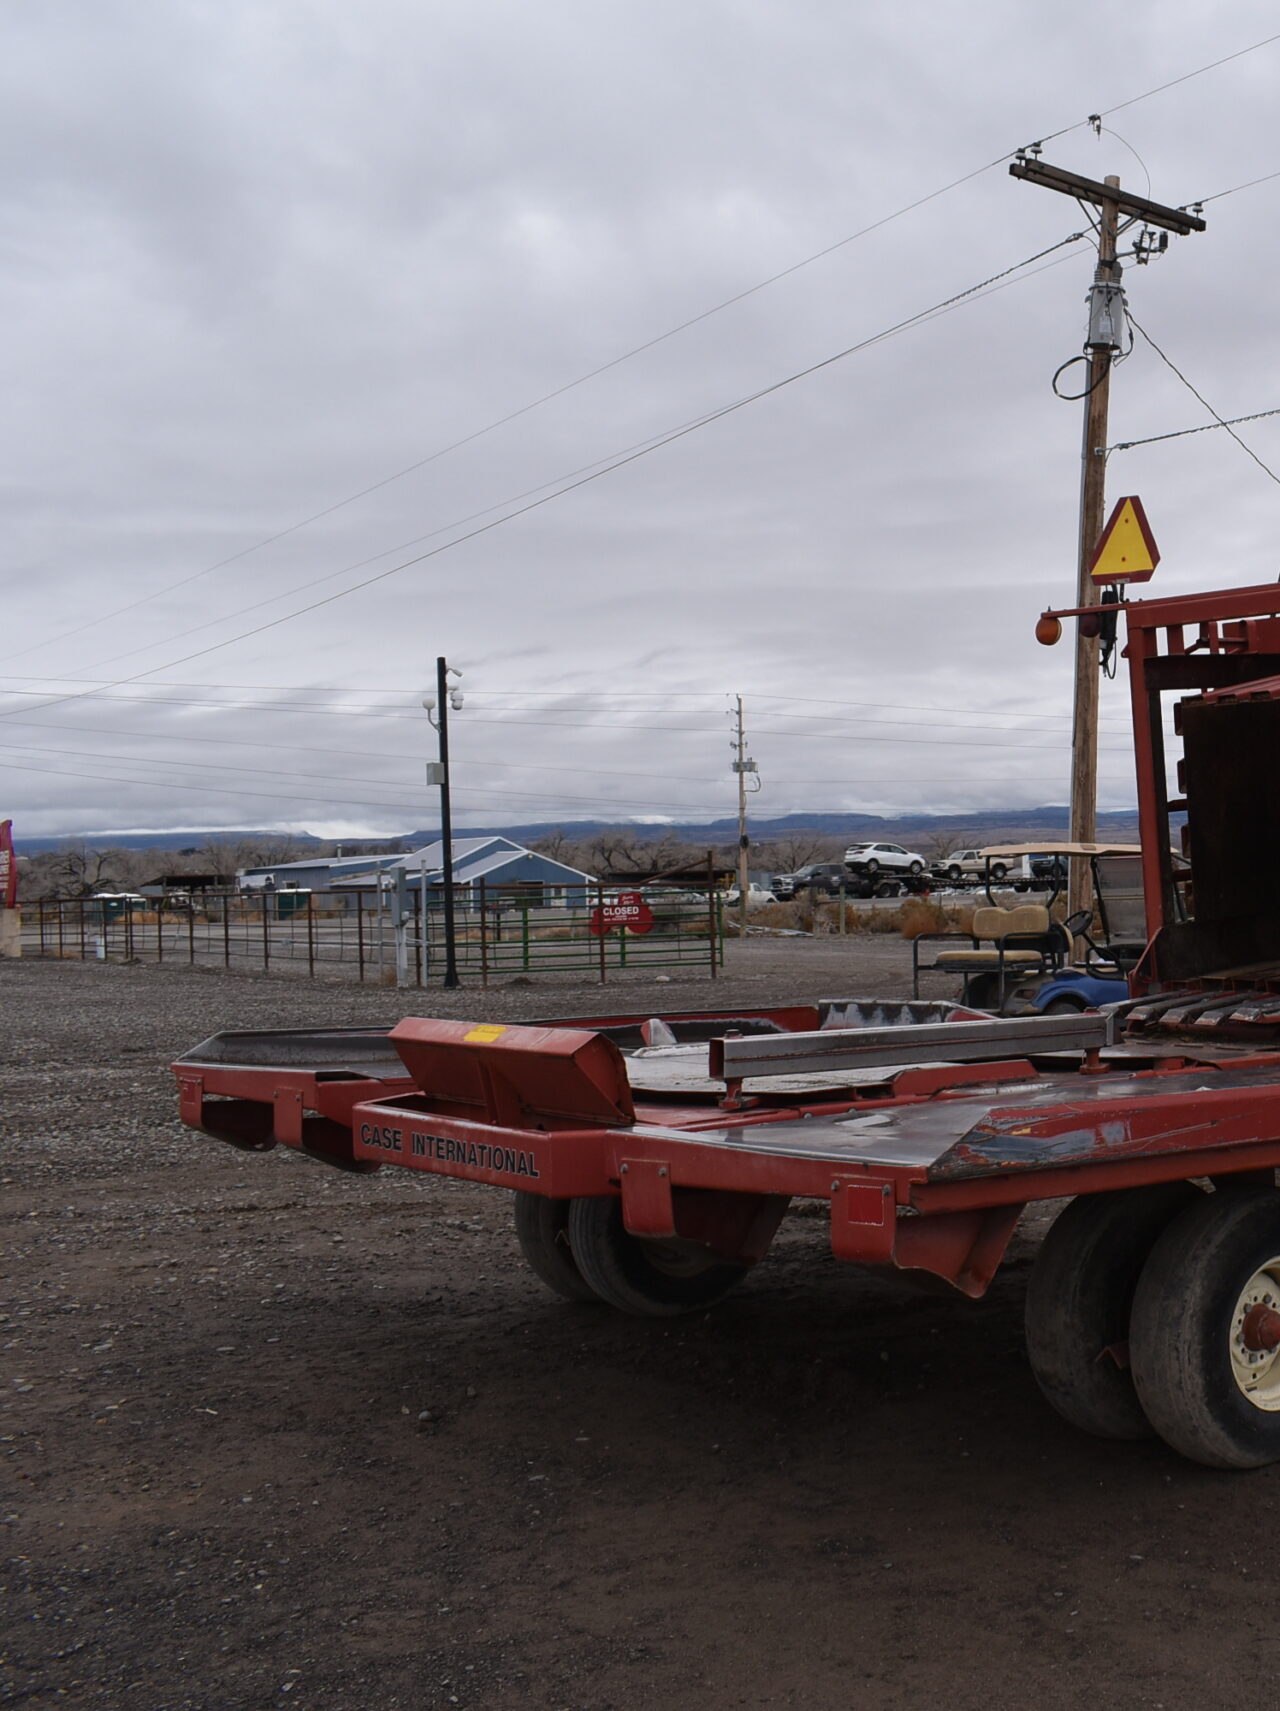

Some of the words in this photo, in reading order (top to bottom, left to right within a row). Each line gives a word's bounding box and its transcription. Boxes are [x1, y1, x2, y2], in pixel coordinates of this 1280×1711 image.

[602, 906, 639, 916] CLOSED
[360, 1122, 403, 1152] CASE
[411, 1131, 540, 1178] INTERNATIONAL
